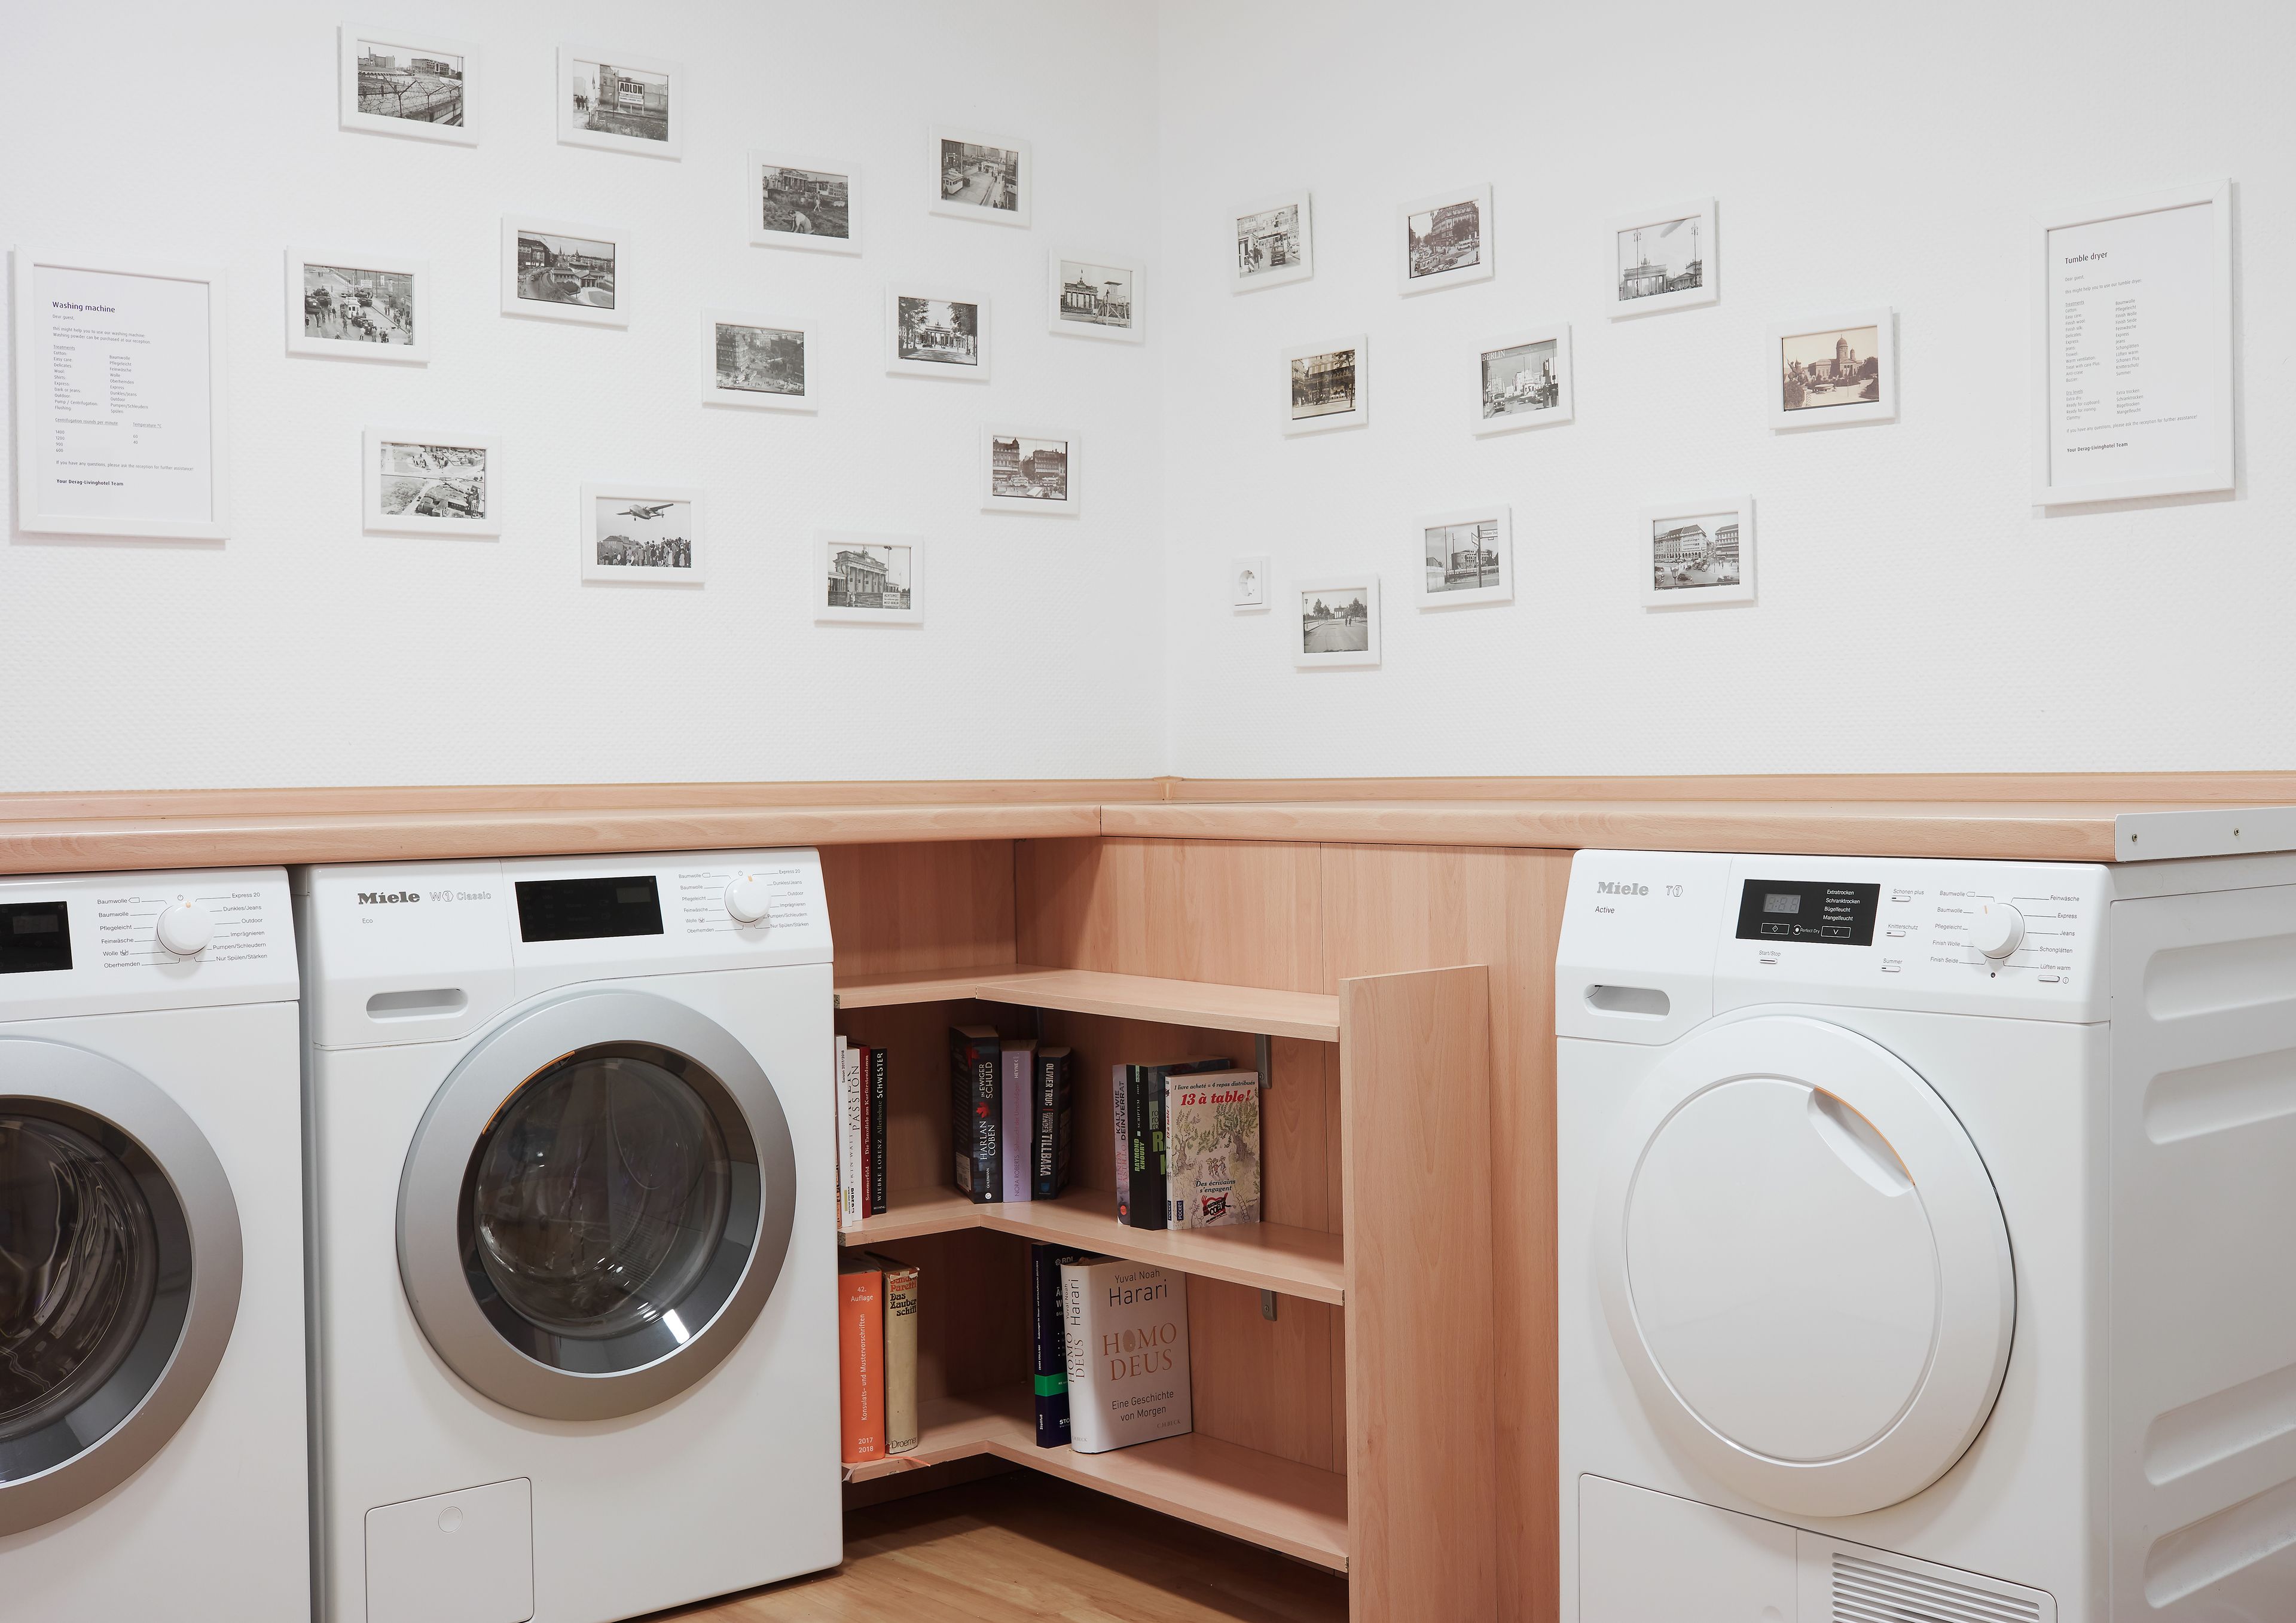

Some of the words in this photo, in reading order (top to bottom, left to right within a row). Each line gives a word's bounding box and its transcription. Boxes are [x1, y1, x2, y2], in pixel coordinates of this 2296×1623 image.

[619, 82, 643, 94] ADLON
[2065, 254, 2089, 264] Tumble
[2090, 252, 2108, 261] dryer
[53, 301, 83, 311] Washing
[85, 304, 115, 313] machine
[1482, 350, 1506, 361] BERLIN
[1596, 881, 1650, 896] Miele
[358, 891, 420, 905] Miele
[456, 891, 491, 901] Classic
[1595, 906, 1616, 914] Active
[1045, 1063, 1054, 1087] OLIVIER
[851, 1066, 860, 1131] PASSION
[1044, 1089, 1052, 1106] TRUC
[1180, 1094, 1196, 1106] 13
[1198, 1093, 1208, 1104] à
[865, 1107, 869, 1115] am
[979, 1120, 988, 1160] HARLAN
[988, 1124, 996, 1156] COBEN
[1040, 1134, 1052, 1176] TILLBAKA
[1199, 1186, 1232, 1195] s'engagent
[1062, 1257, 1073, 1265] BDI
[1115, 1273, 1137, 1284] Yuval
[1140, 1269, 1161, 1279] Noah
[890, 1283, 917, 1292] Paretti
[1109, 1279, 1168, 1307] Harari
[890, 1292, 906, 1301] Das
[1068, 1279, 1080, 1327] Harari
[890, 1299, 917, 1309] Zauber
[896, 1307, 917, 1316] schiff
[1065, 1332, 1075, 1383] HOMO
[1074, 1339, 1085, 1379] DEUS
[1110, 1349, 1173, 1381] DEUS
[1112, 1399, 1129, 1410] Eine
[1131, 1390, 1174, 1405] Geschichte
[1120, 1413, 1135, 1422] von
[1137, 1405, 1166, 1420] Morgen
[891, 1437, 917, 1450] Droemer
